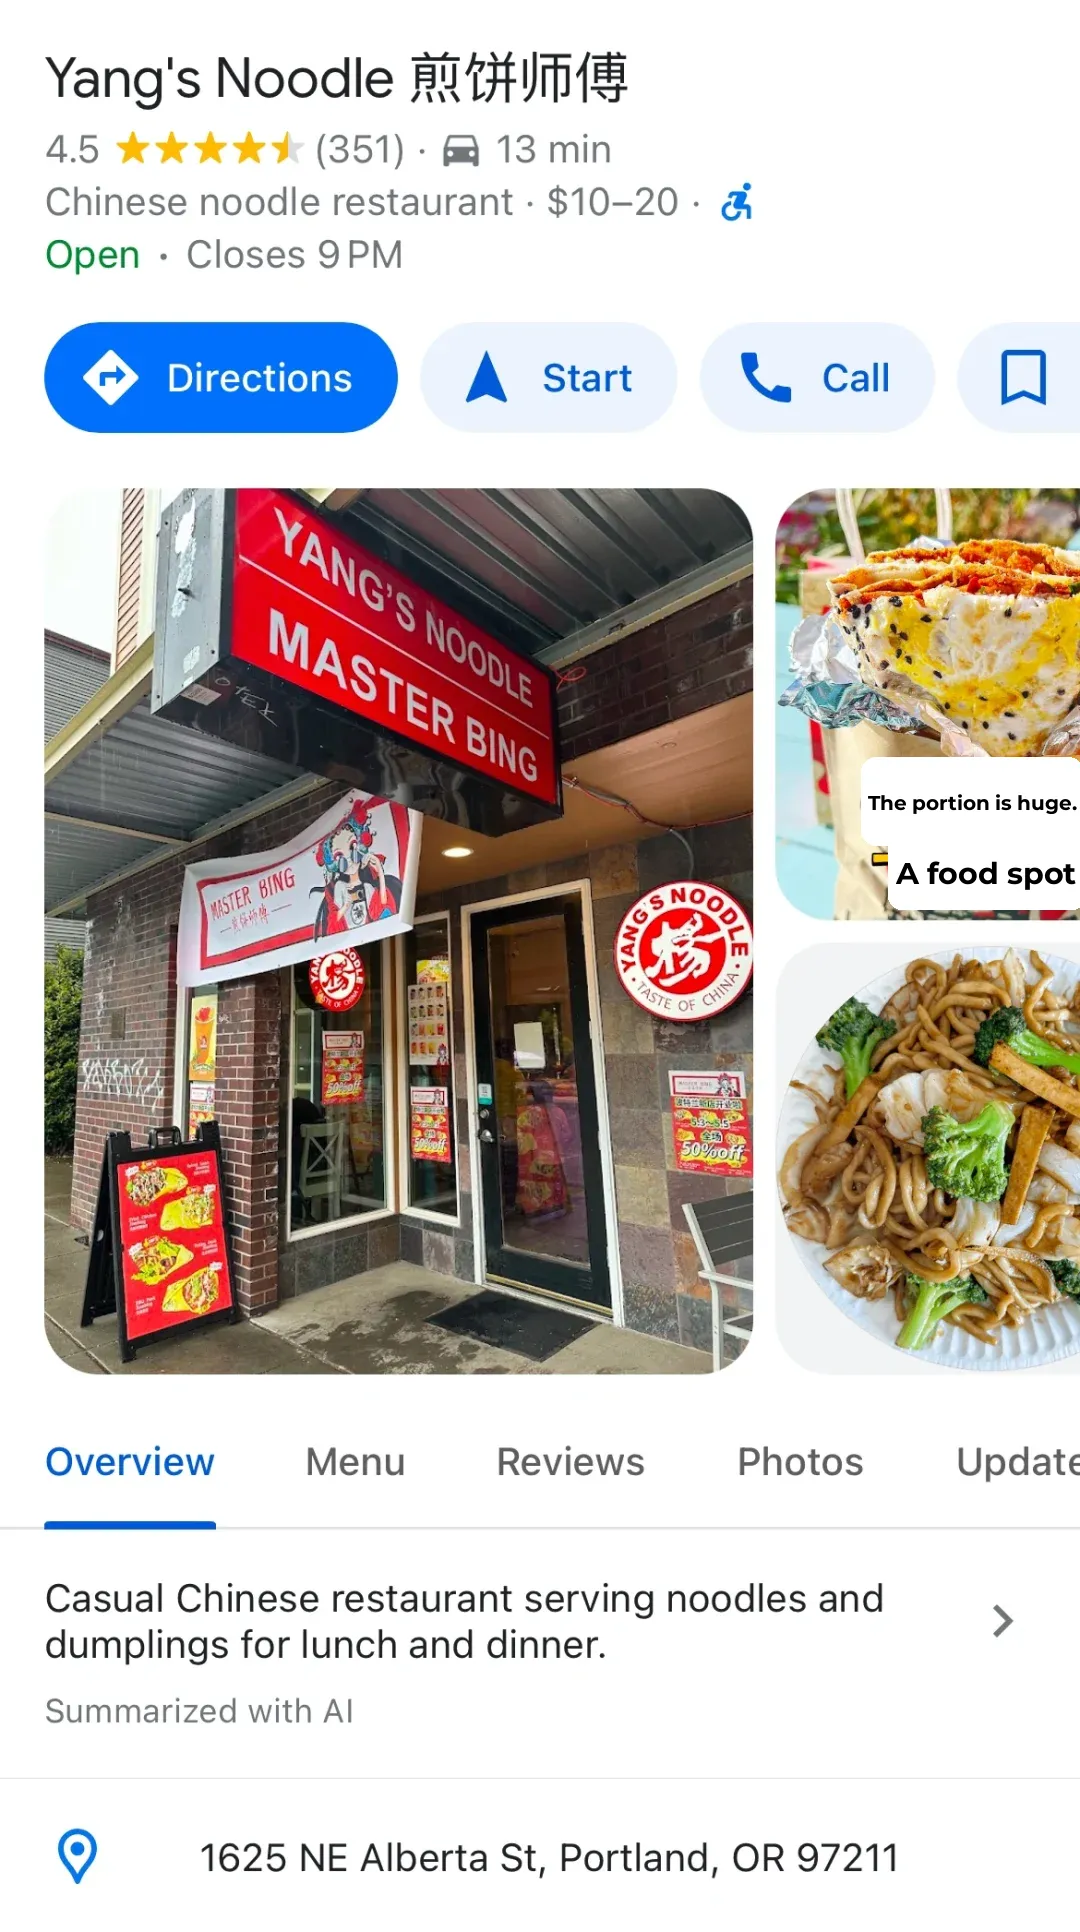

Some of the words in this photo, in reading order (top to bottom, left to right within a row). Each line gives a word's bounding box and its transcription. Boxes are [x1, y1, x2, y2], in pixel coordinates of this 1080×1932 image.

[45, 57, 200, 110] Yang's
[218, 57, 393, 98] Noodle
[411, 51, 628, 103] 煎饼师傅
[46, 135, 98, 163] 4.5
[317, 134, 403, 170] (351)
[498, 135, 535, 163] 13
[550, 134, 610, 163] min
[47, 186, 186, 216] Chinese
[201, 186, 319, 216] noodle
[334, 187, 513, 216] restaurant
[46, 240, 139, 275] Open
[188, 239, 305, 269] Closes
[169, 361, 352, 392] Directions
[544, 363, 632, 393] Start
[823, 362, 888, 393] Call
[425, 609, 533, 709] NOODLE
[268, 607, 456, 745] MASTER
[466, 714, 537, 782] BING
[210, 886, 252, 920] MASTER
[258, 867, 295, 899] BING
[670, 887, 748, 956] NOODLE
[637, 981, 672, 1010] TASTE
[678, 999, 696, 1012] OF
[702, 972, 740, 1006] CHINA
[681, 1141, 744, 1161] 50%off
[46, 1445, 215, 1476] Overview
[308, 1447, 404, 1476] Menu
[499, 1445, 644, 1476] Reviews
[740, 1446, 863, 1476] Photos
[46, 1583, 162, 1613] Casual
[177, 1583, 319, 1613] Chinese
[333, 1586, 512, 1613] restaurant
[525, 1583, 653, 1620] serving
[668, 1583, 806, 1613] noodles
[819, 1583, 882, 1613] and
[46, 1629, 228, 1666] dumplings
[241, 1629, 290, 1659] for
[303, 1629, 396, 1659] lunch
[410, 1629, 472, 1659] and
[487, 1629, 605, 1659] dinner.
[46, 1698, 236, 1723] Summarized
[248, 1698, 311, 1723] with
[324, 1699, 351, 1723] AI
[201, 1843, 286, 1872] 1625
[301, 1843, 347, 1871] NE
[360, 1842, 487, 1872] Alberta
[501, 1843, 545, 1879] St,
[562, 1842, 718, 1879] Portland,
[733, 1843, 784, 1872] OR
[798, 1843, 895, 1872] 97211
